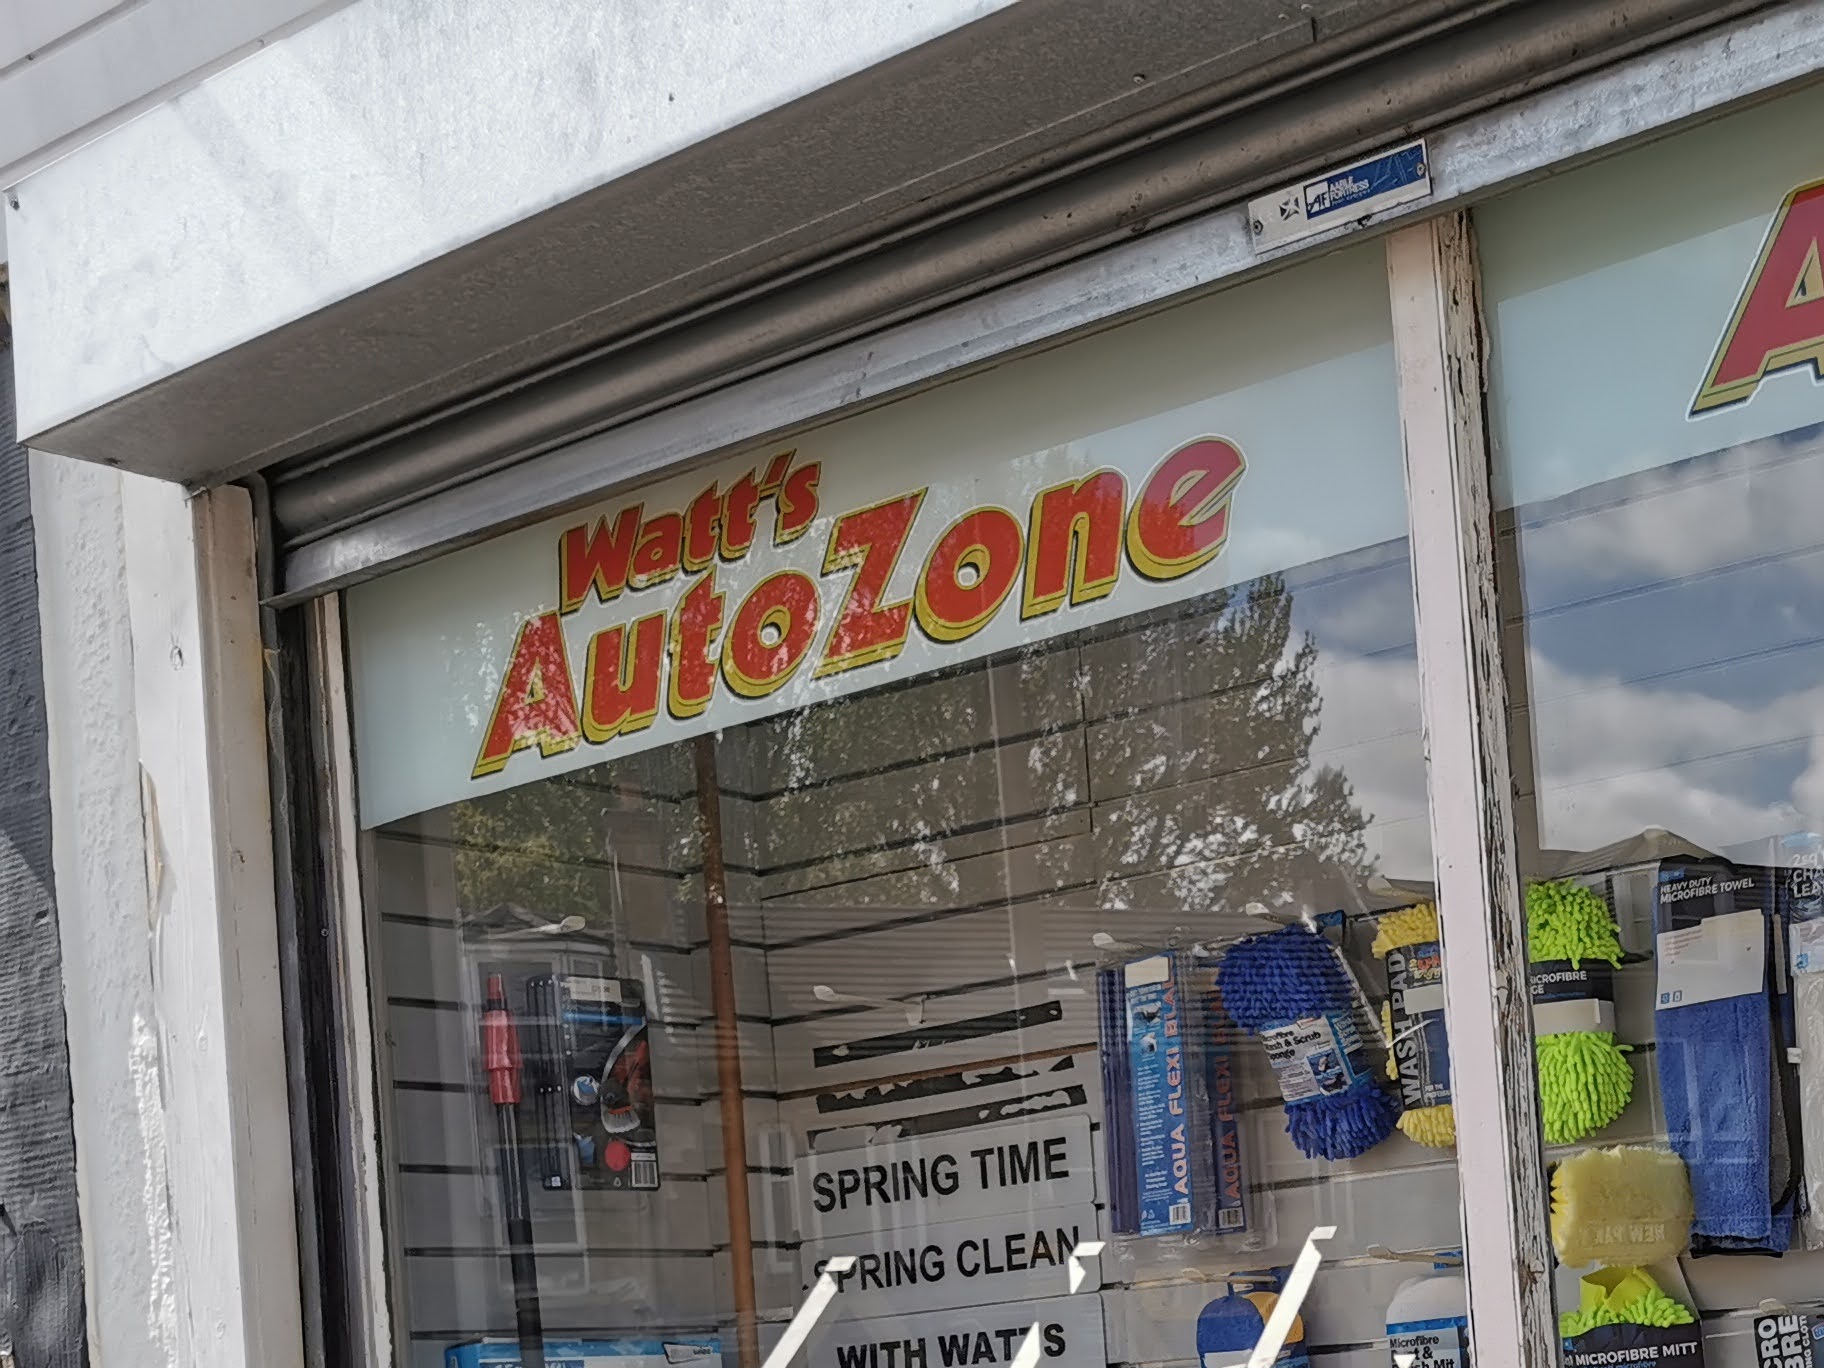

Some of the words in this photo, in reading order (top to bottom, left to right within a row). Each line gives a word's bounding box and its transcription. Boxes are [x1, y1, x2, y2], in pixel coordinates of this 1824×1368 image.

[559, 448, 822, 613] Watt's
[471, 432, 1250, 780] AutoZone
[1660, 882, 1688, 895] HEAVY
[1689, 877, 1713, 891] DUTY
[1660, 884, 1718, 904] MICROFIBRE
[1719, 878, 1756, 893] TOWEL
[1387, 950, 1408, 1012] PAD
[1166, 1047, 1183, 1117] FLEXI
[1393, 1018, 1422, 1106] WASH
[813, 1153, 959, 1213] SPRING
[971, 1137, 1069, 1190] TIME
[1170, 1124, 1189, 1195] AQUA
[957, 1226, 1079, 1277] CLEAN
[1389, 1335, 1440, 1349] Microfibre
[1574, 1346, 1659, 1367] MICROFIBRE
[1662, 1341, 1698, 1357] MITT
